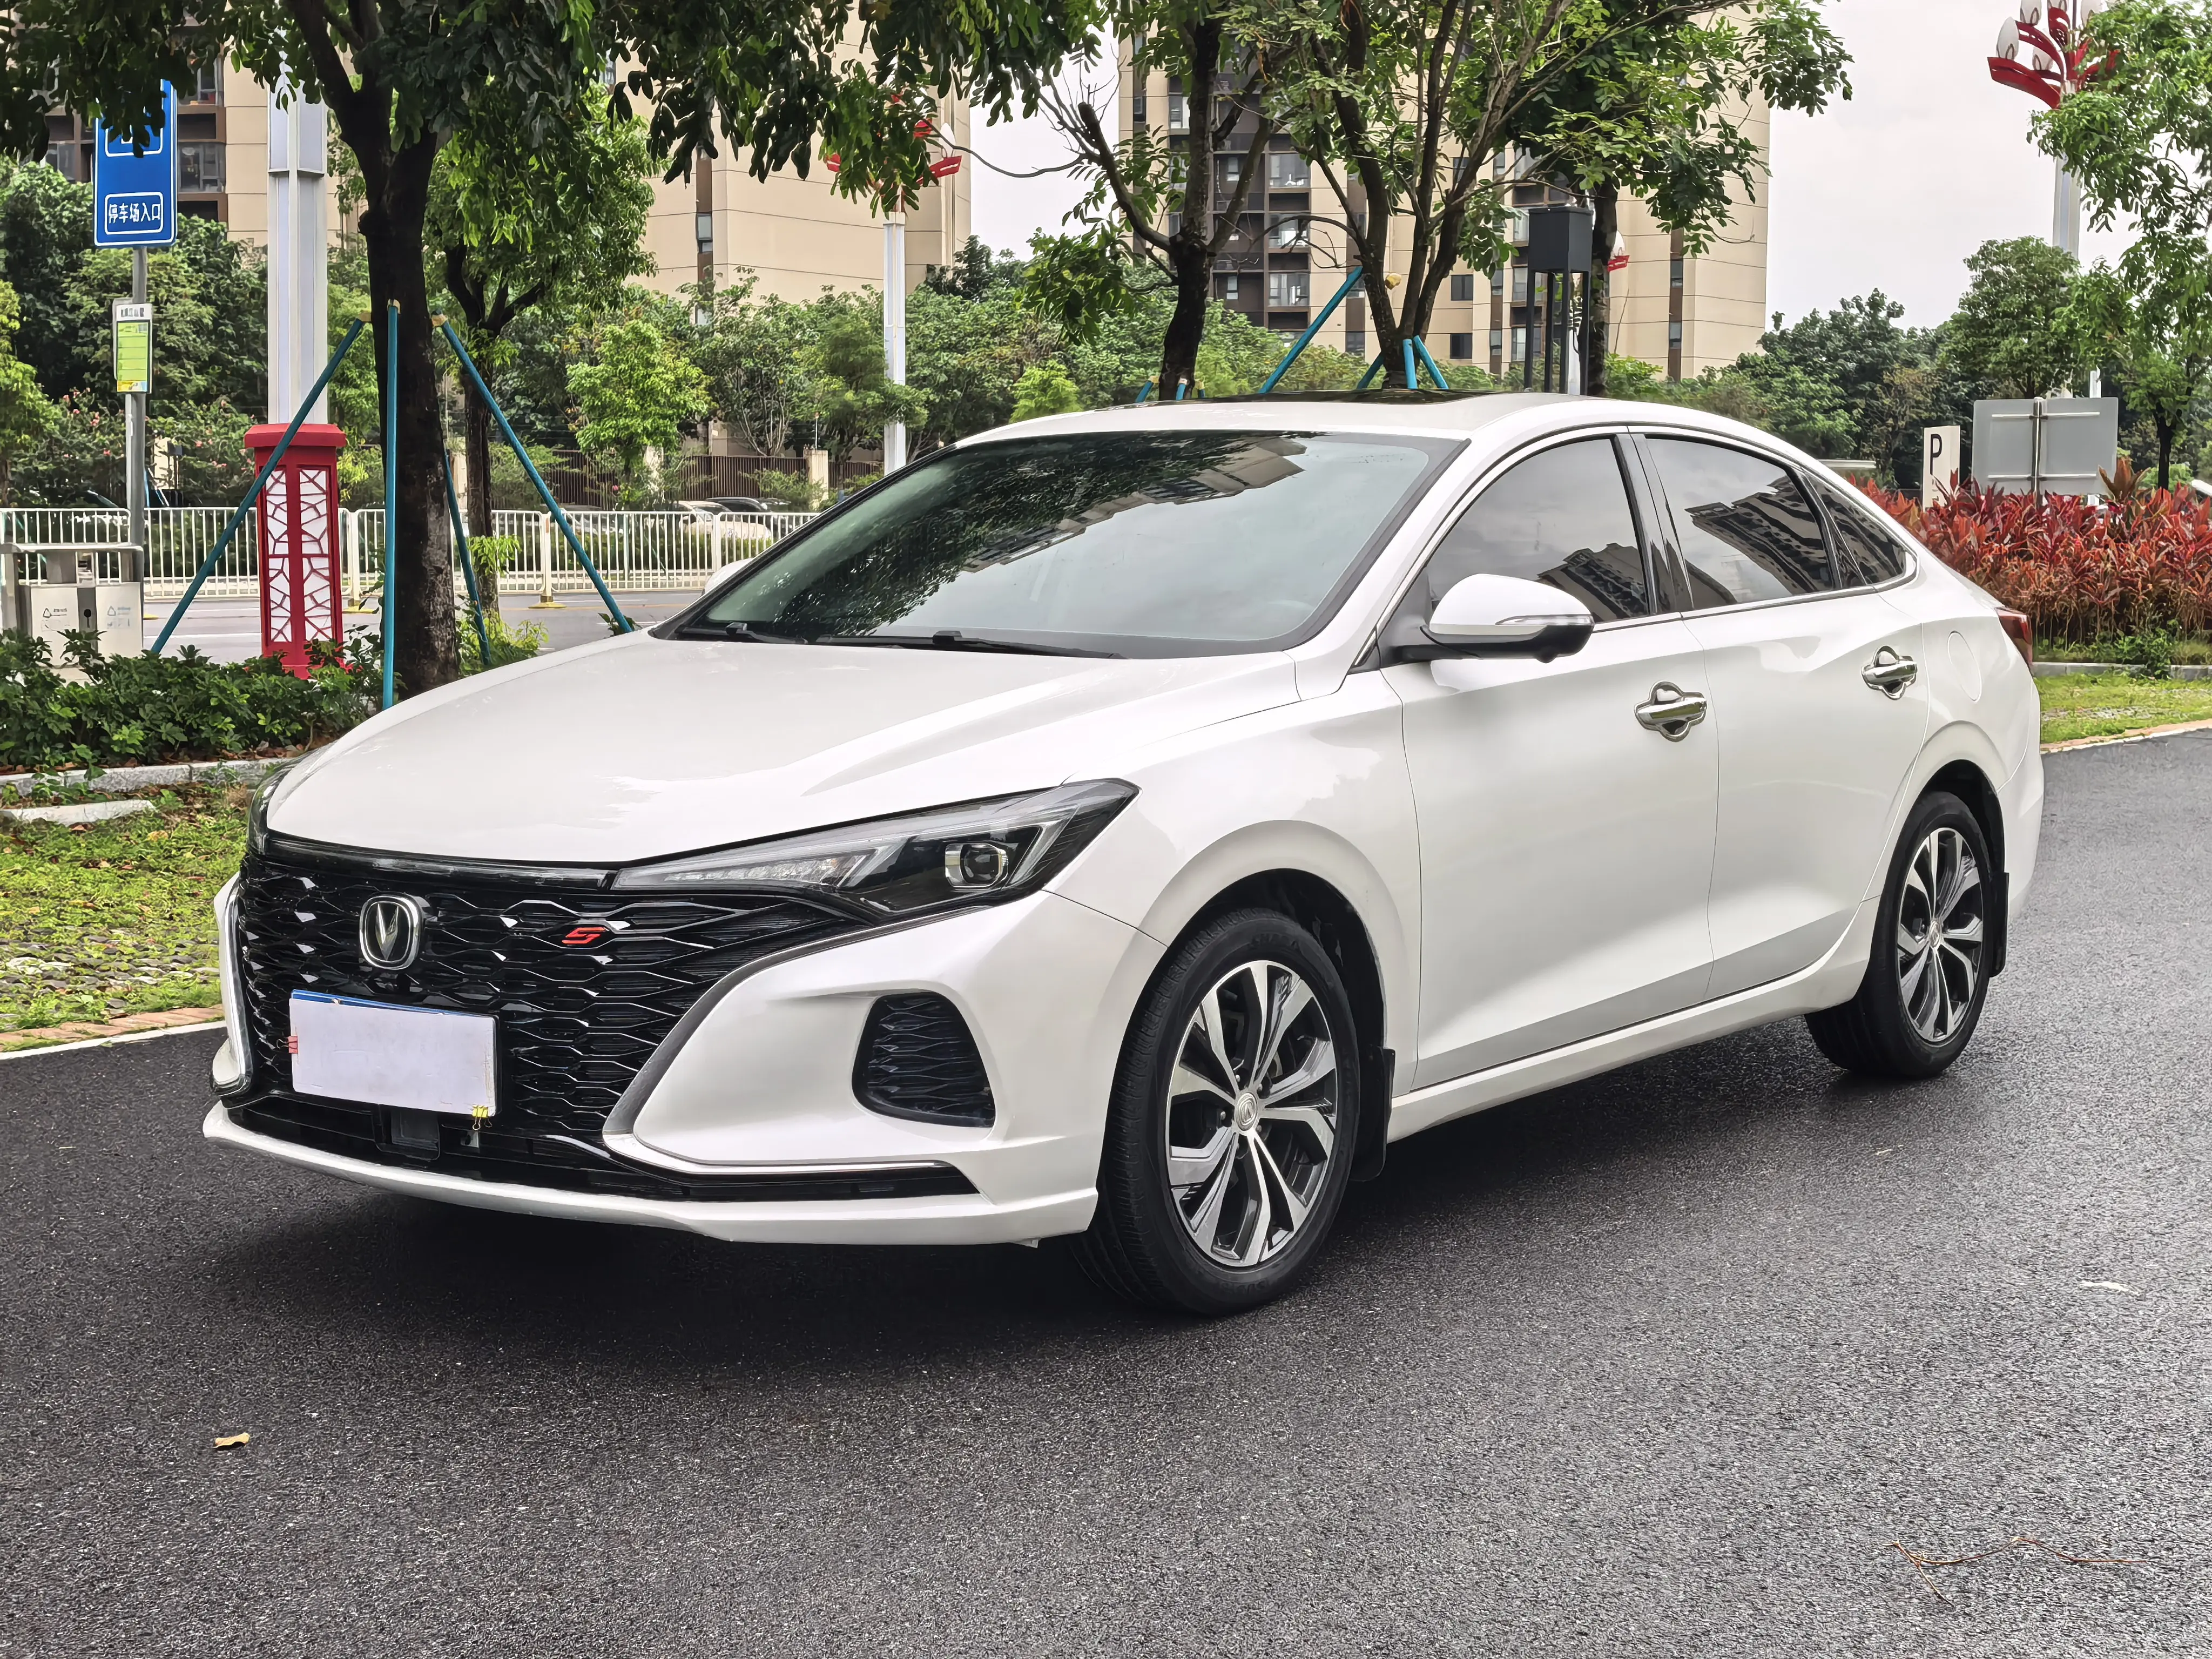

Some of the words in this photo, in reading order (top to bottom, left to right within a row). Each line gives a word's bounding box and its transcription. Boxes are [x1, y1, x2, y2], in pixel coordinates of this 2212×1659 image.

[108, 203, 160, 224] 停车场入口
[1930, 433, 1943, 476] P
